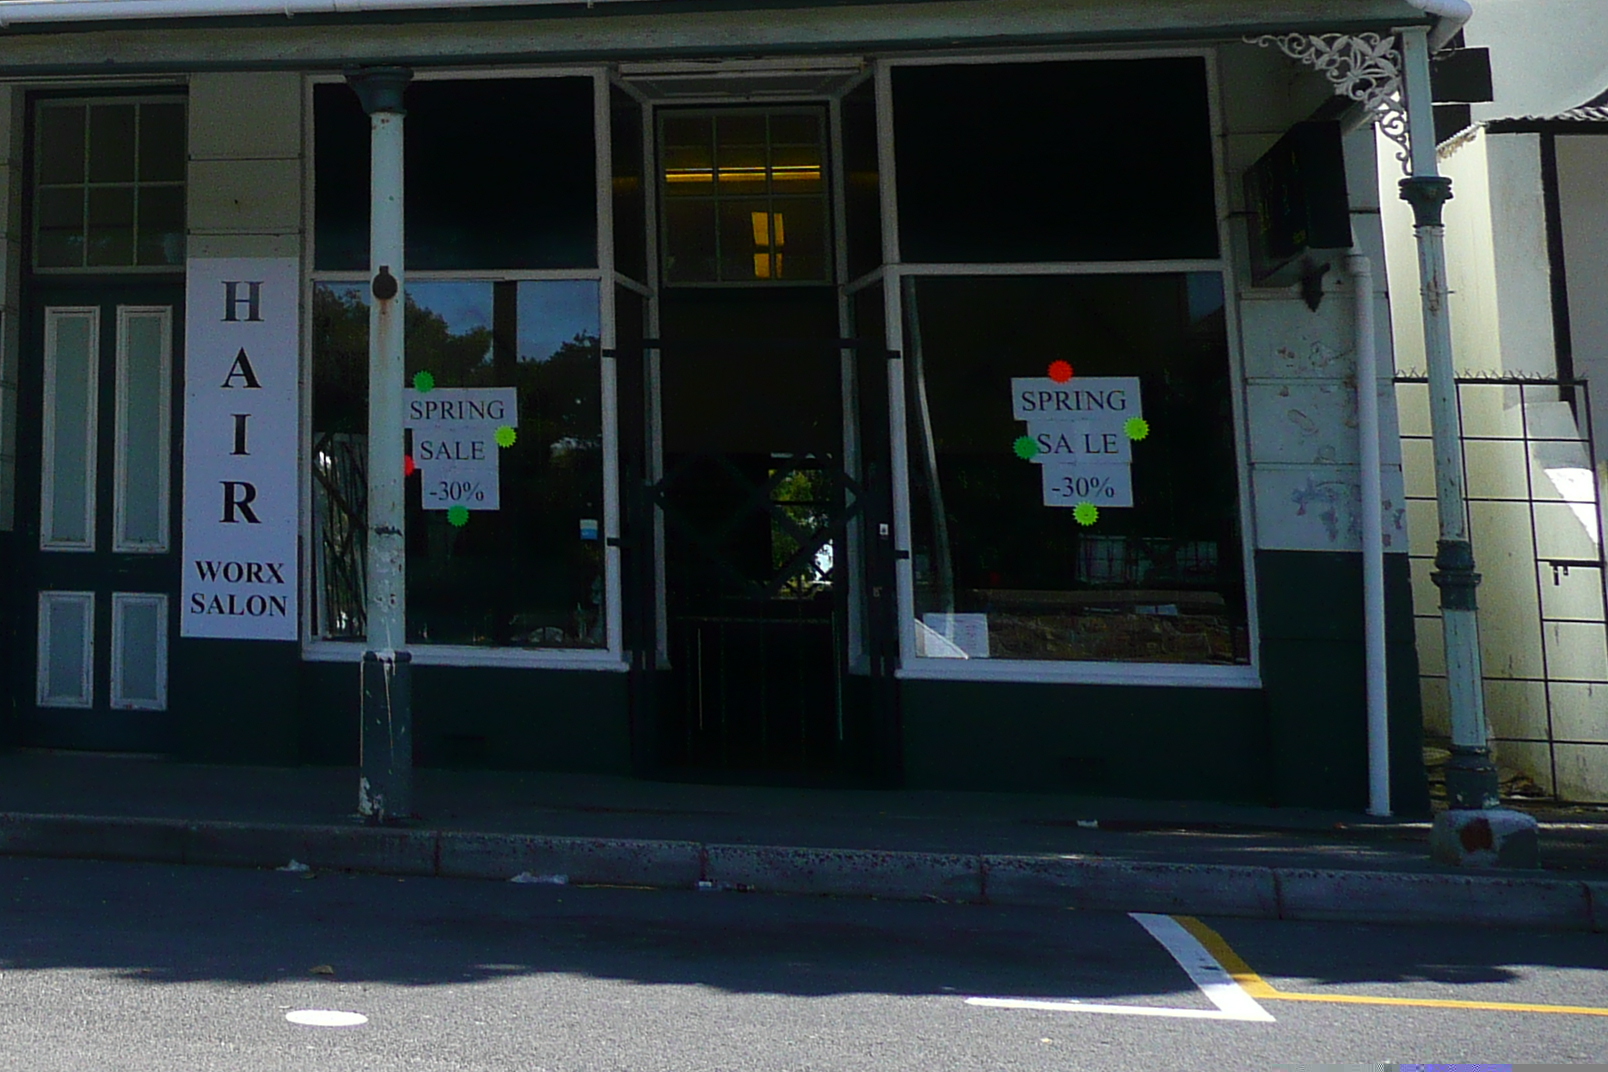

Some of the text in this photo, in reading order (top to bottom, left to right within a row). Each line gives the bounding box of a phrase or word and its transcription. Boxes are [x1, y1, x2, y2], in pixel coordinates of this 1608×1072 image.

[218, 279, 265, 525] HAIR
[409, 399, 505, 421] SPRING
[1021, 390, 1127, 412] SPRING
[419, 441, 487, 461] SALE
[1036, 433, 1120, 455] SALE
[429, 480, 484, 503] -30%
[1050, 476, 1115, 499] -30%
[195, 560, 285, 585] WORX
[190, 593, 288, 618] SALON
